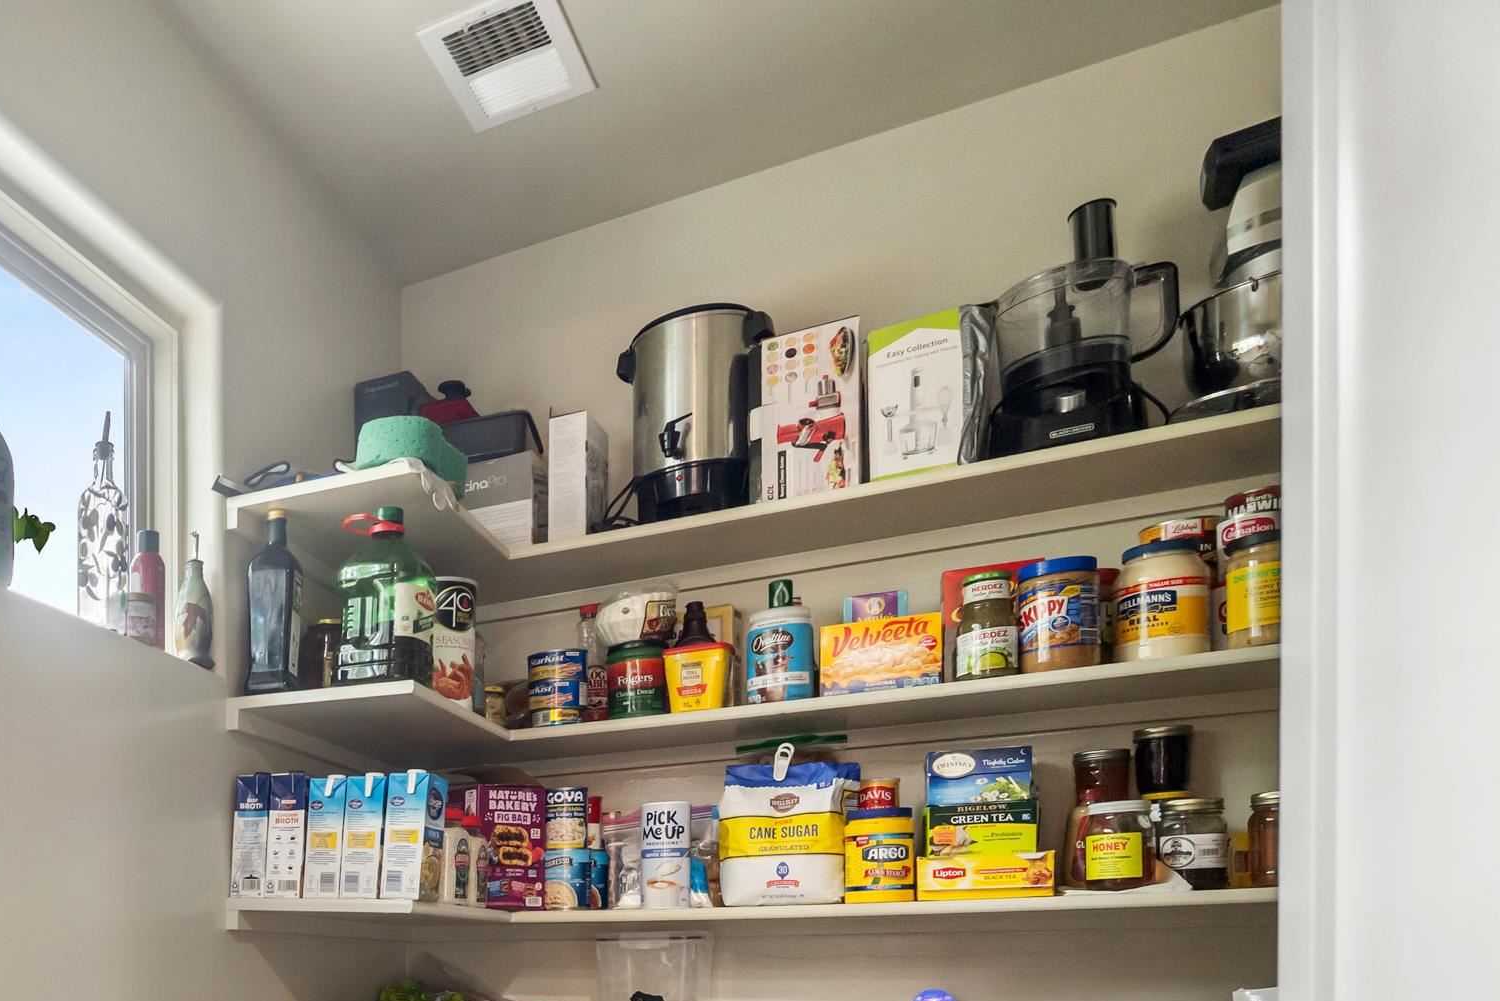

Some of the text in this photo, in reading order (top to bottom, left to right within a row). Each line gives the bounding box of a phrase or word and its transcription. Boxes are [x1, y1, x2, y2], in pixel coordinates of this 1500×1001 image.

[886, 346, 906, 360] Easy
[906, 336, 949, 355] Collection
[1246, 494, 1272, 504] Hunt's
[1227, 498, 1280, 517] MANWI
[1172, 523, 1198, 534] Libby's
[1222, 523, 1273, 542] Carnation
[971, 583, 1004, 593] HERDEZ
[1149, 580, 1170, 588] VALUE
[1119, 592, 1172, 611] HELLMANN'S
[438, 592, 472, 627] 4C
[1018, 598, 1065, 632] SKIPPY
[1129, 616, 1159, 626] REAL
[832, 616, 930, 658] Velveeta
[972, 630, 1008, 641] HERDEZ
[752, 632, 792, 652] Ovaltine
[531, 653, 565, 666] StarKist
[618, 673, 653, 686] Folgers
[936, 760, 972, 771] TWININGS
[982, 758, 1006, 767] Nightly
[547, 791, 584, 804] GOYA
[860, 788, 892, 801] DAVIS
[240, 802, 263, 810] BROTH
[489, 800, 537, 812] BAKERY
[957, 804, 1008, 812] BIGELOW
[275, 817, 299, 825] BROTH
[497, 813, 528, 823] FIG BAR
[774, 818, 793, 826] PURE
[950, 812, 1014, 824] GREEN TEA
[665, 825, 685, 840] UP
[750, 824, 819, 840] CANE SUGAR
[1092, 841, 1128, 852] HONEY
[867, 846, 906, 860] ARGO
[867, 869, 885, 877] CORN
[935, 870, 964, 880] Lipton
